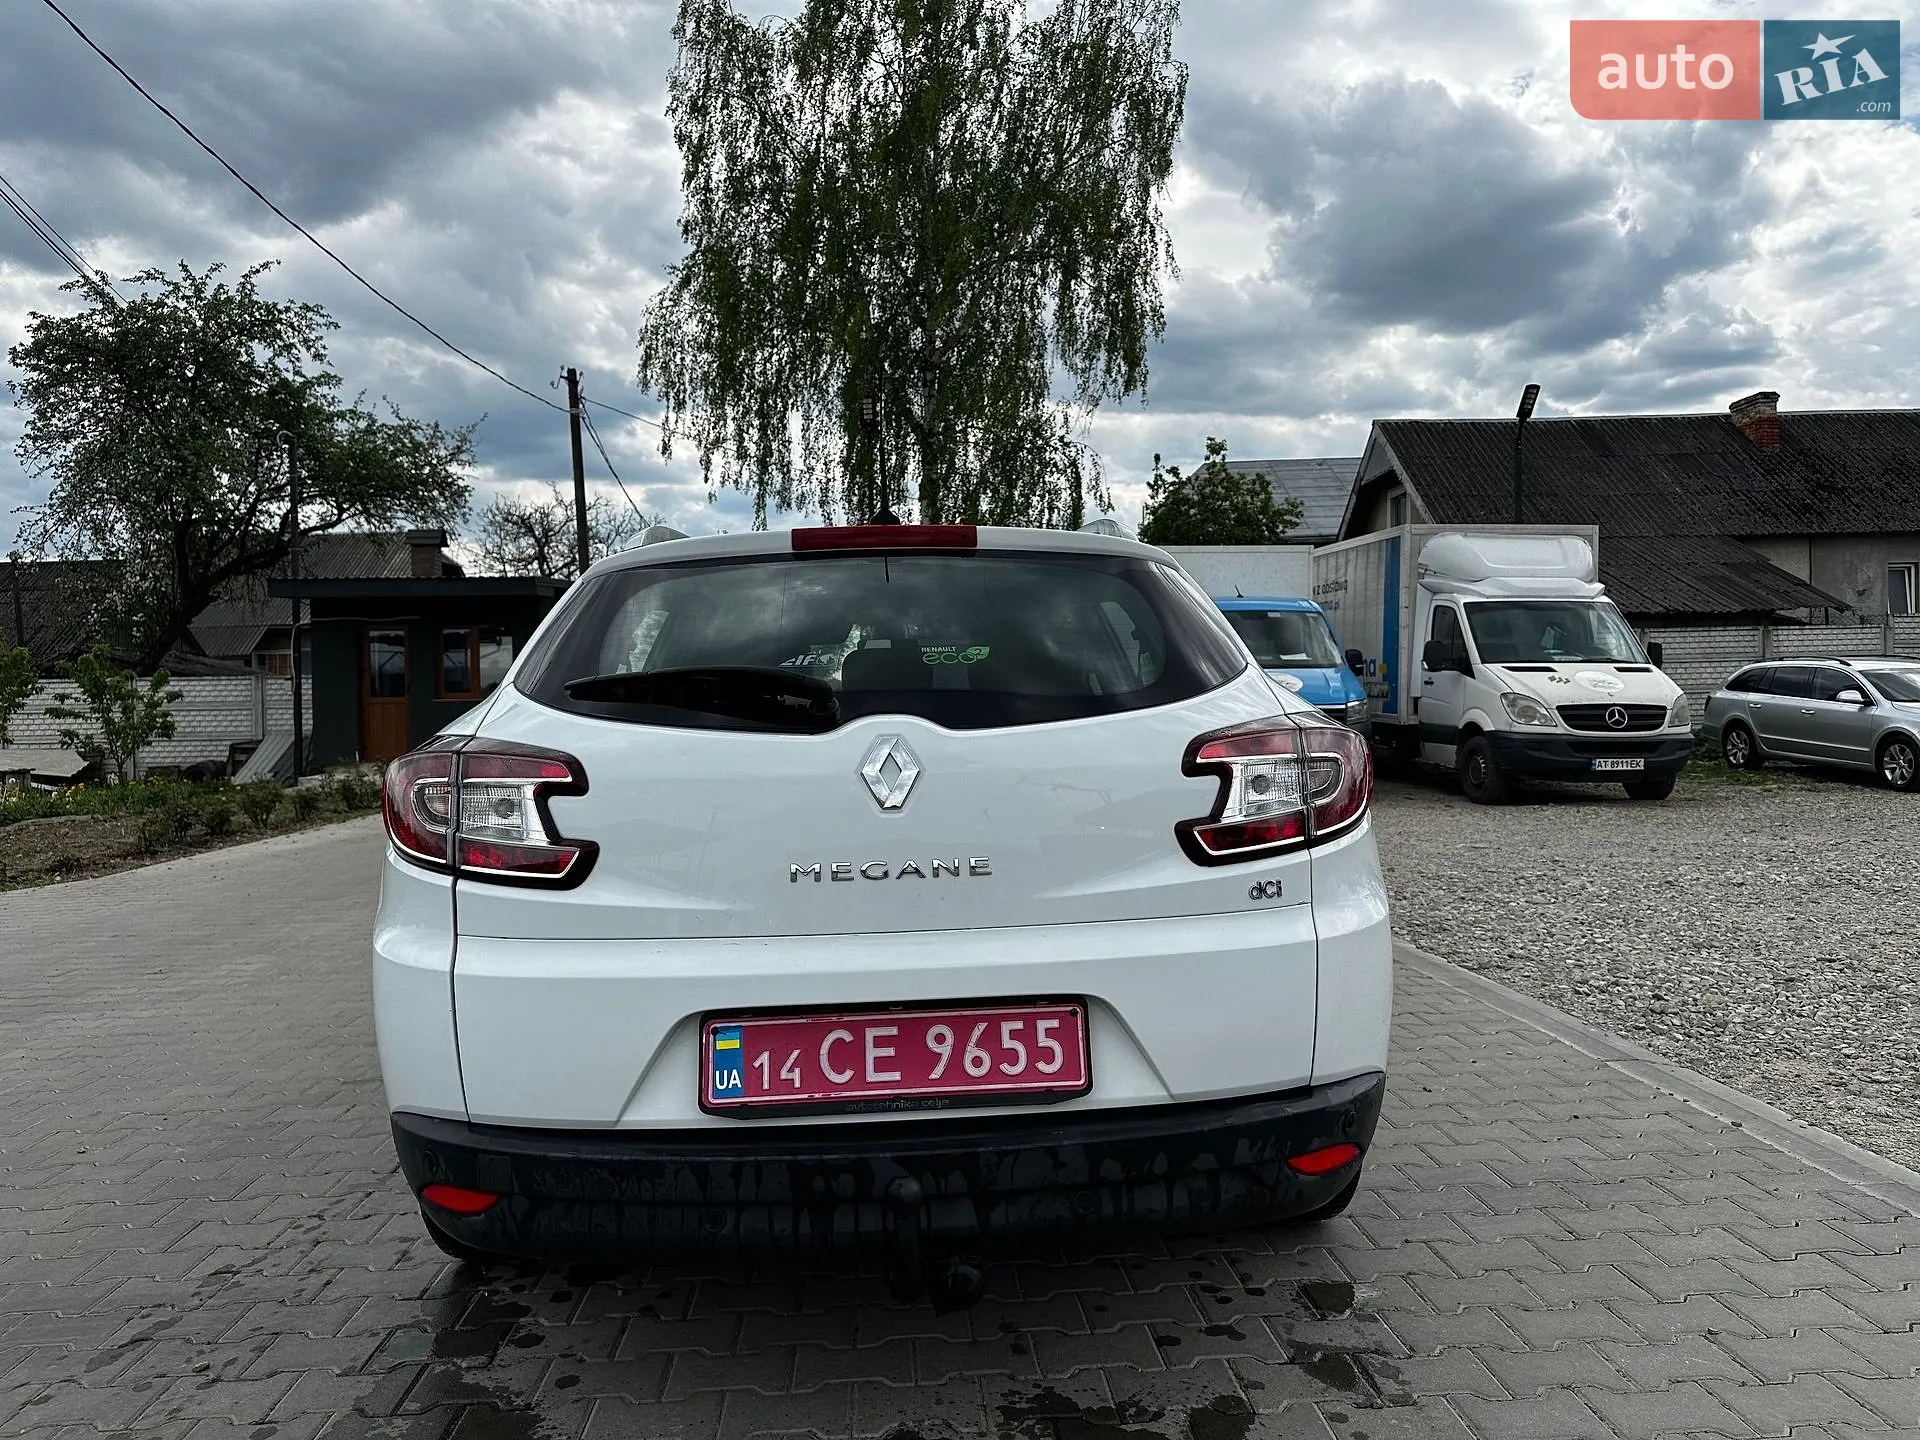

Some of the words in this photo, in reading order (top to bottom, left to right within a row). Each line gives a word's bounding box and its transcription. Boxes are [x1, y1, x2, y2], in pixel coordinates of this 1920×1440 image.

[1597, 759, 1609, 769] AT
[789, 856, 993, 883] MEGANE
[1248, 879, 1283, 901] dCi
[715, 1069, 742, 1091] UA
[752, 1048, 802, 1091] 14
[818, 1025, 903, 1084] CE
[924, 1018, 1065, 1081] 9655
